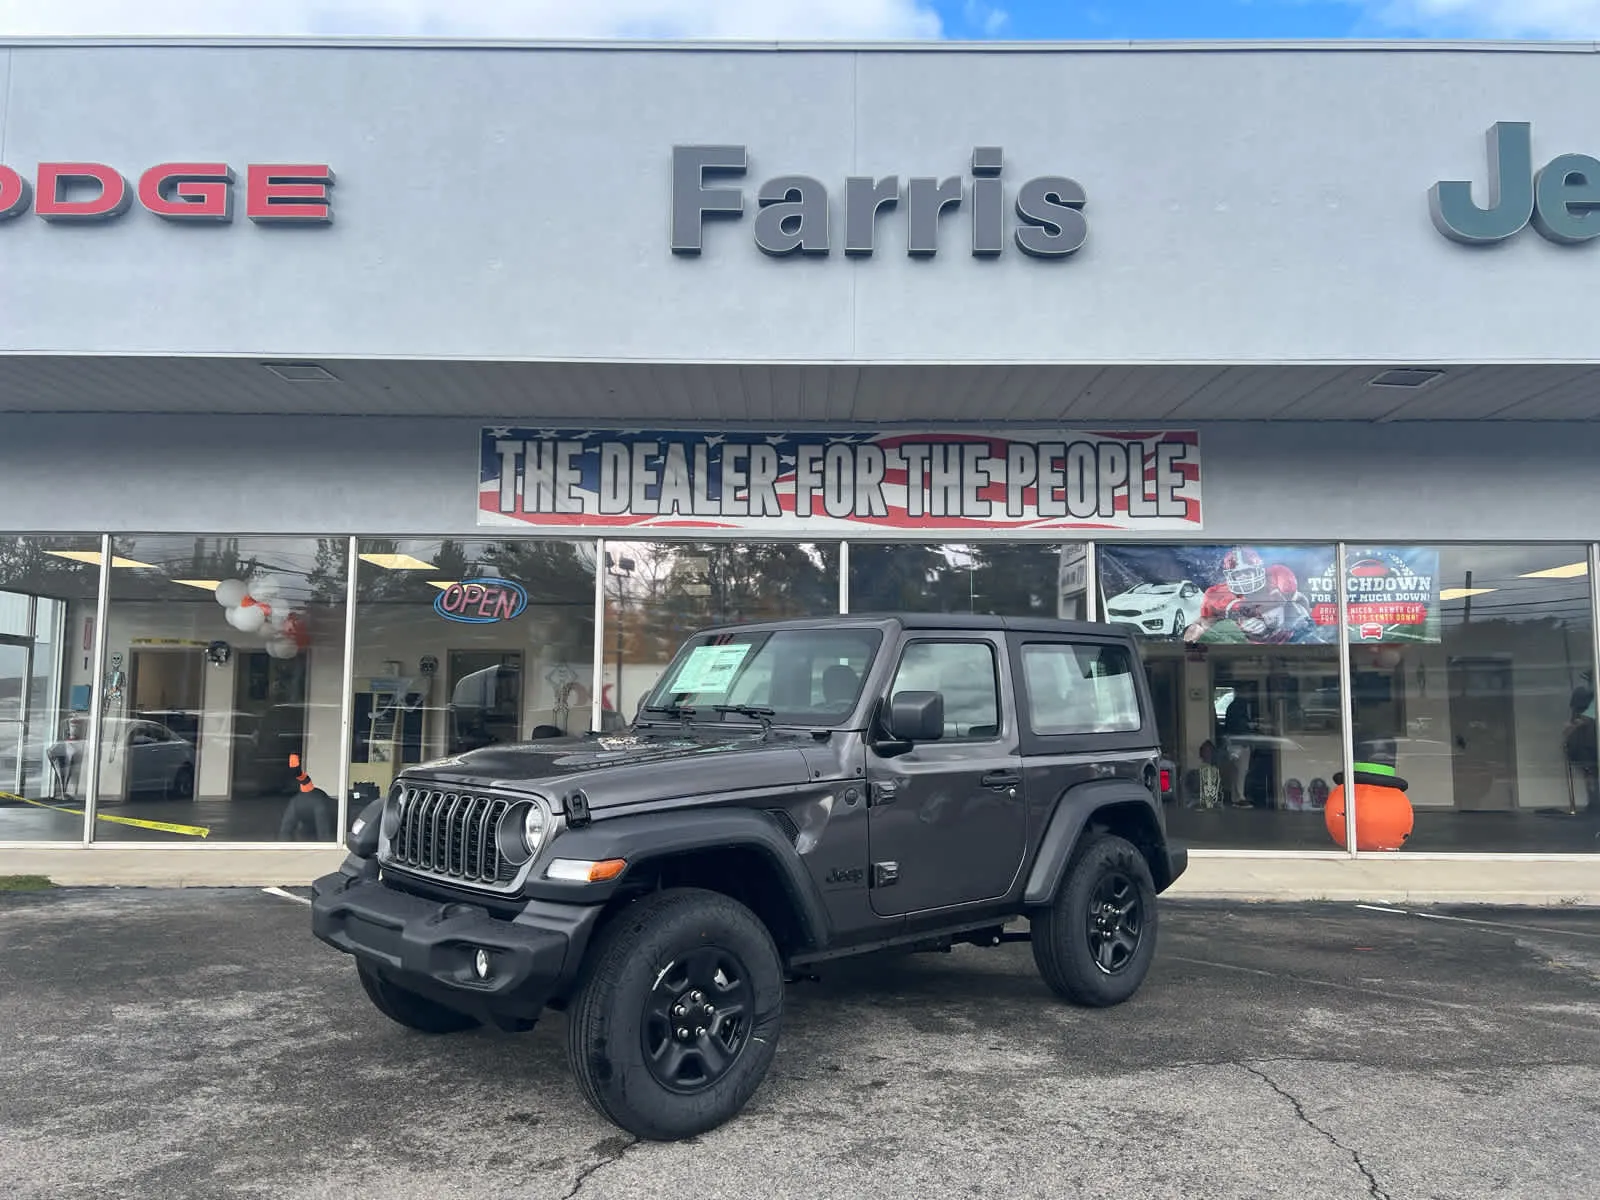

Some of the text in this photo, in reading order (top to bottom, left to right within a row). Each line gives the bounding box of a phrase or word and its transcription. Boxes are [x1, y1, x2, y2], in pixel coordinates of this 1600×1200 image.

[0, 162, 335, 225] DGE
[671, 144, 1089, 256] Farris
[1427, 121, 1600, 247] Je
[495, 439, 1188, 518] THE DEALER FOR THE PEOPLE
[442, 583, 518, 619] OPEN
[1308, 577, 1431, 592] TOCHDOWN
[1311, 593, 1331, 603] FOR
[1360, 593, 1391, 602] MUCH
[1395, 592, 1431, 602] DOWN!
